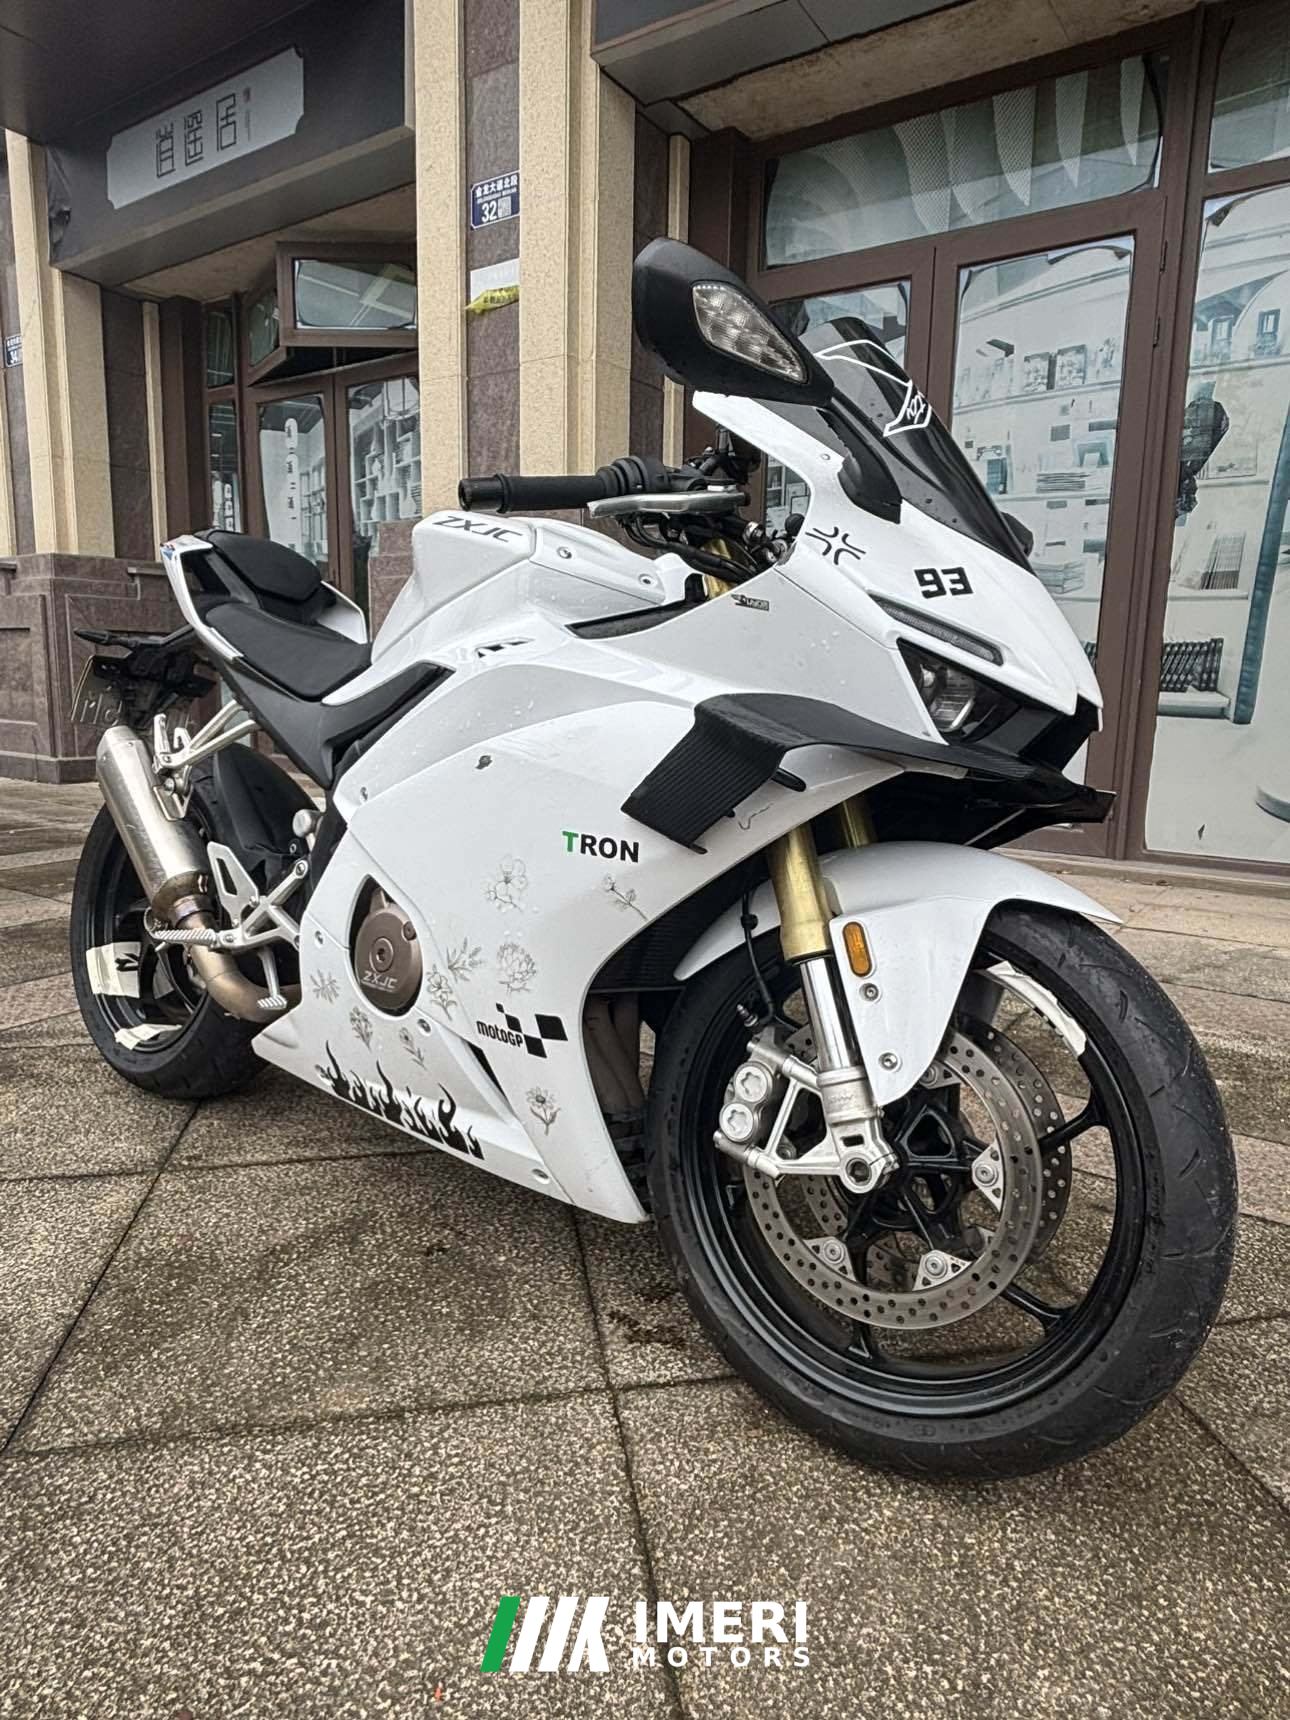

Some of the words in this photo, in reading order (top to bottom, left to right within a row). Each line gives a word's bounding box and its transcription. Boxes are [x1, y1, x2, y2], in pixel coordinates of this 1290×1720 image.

[481, 200, 498, 223] 32
[914, 566, 974, 599] 93
[562, 830, 640, 863] TRON
